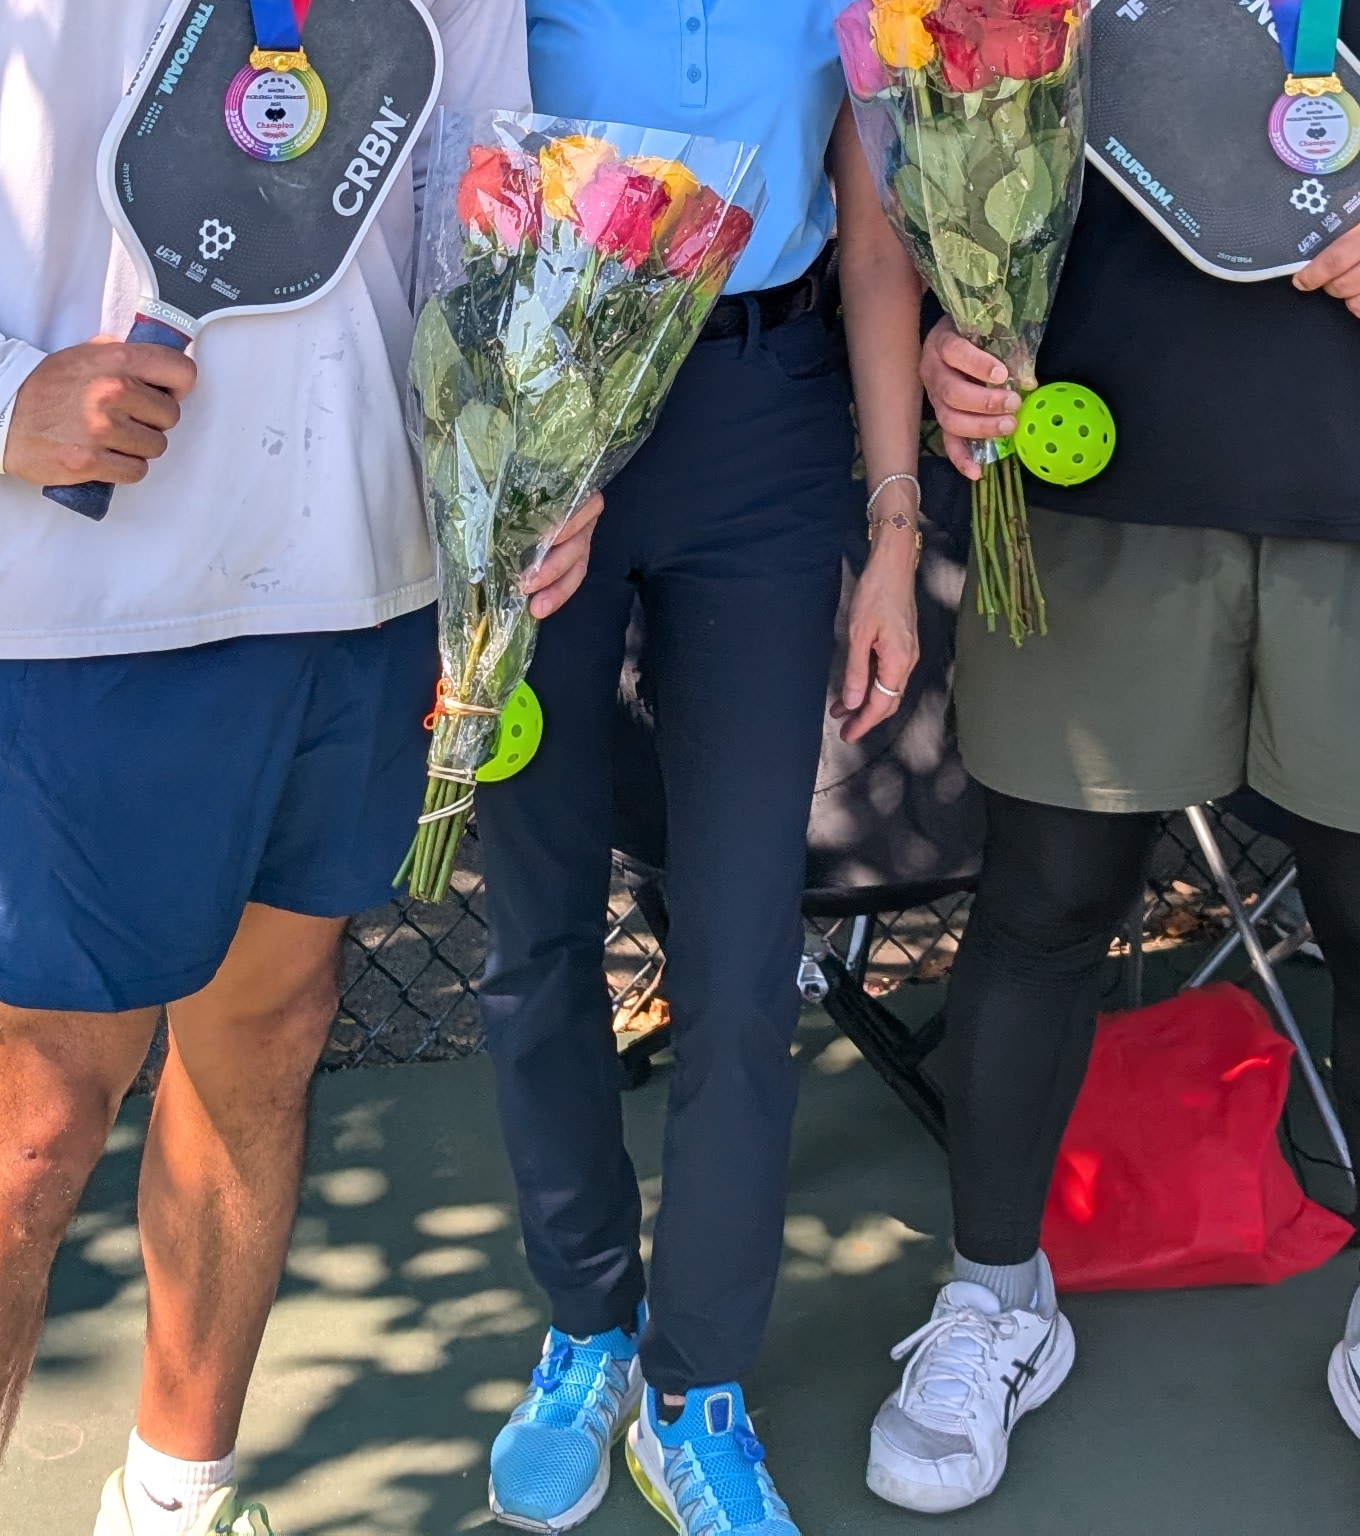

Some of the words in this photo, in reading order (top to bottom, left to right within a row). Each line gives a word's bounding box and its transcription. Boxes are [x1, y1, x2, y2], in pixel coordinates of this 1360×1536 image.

[159, 3, 214, 95] TRUFOAM
[1104, 136, 1174, 207] TRUFOAM
[1321, 212, 1338, 227] USA
[155, 245, 182, 266] UPA
[190, 261, 208, 276] USA
[162, 309, 192, 330] CRBN
